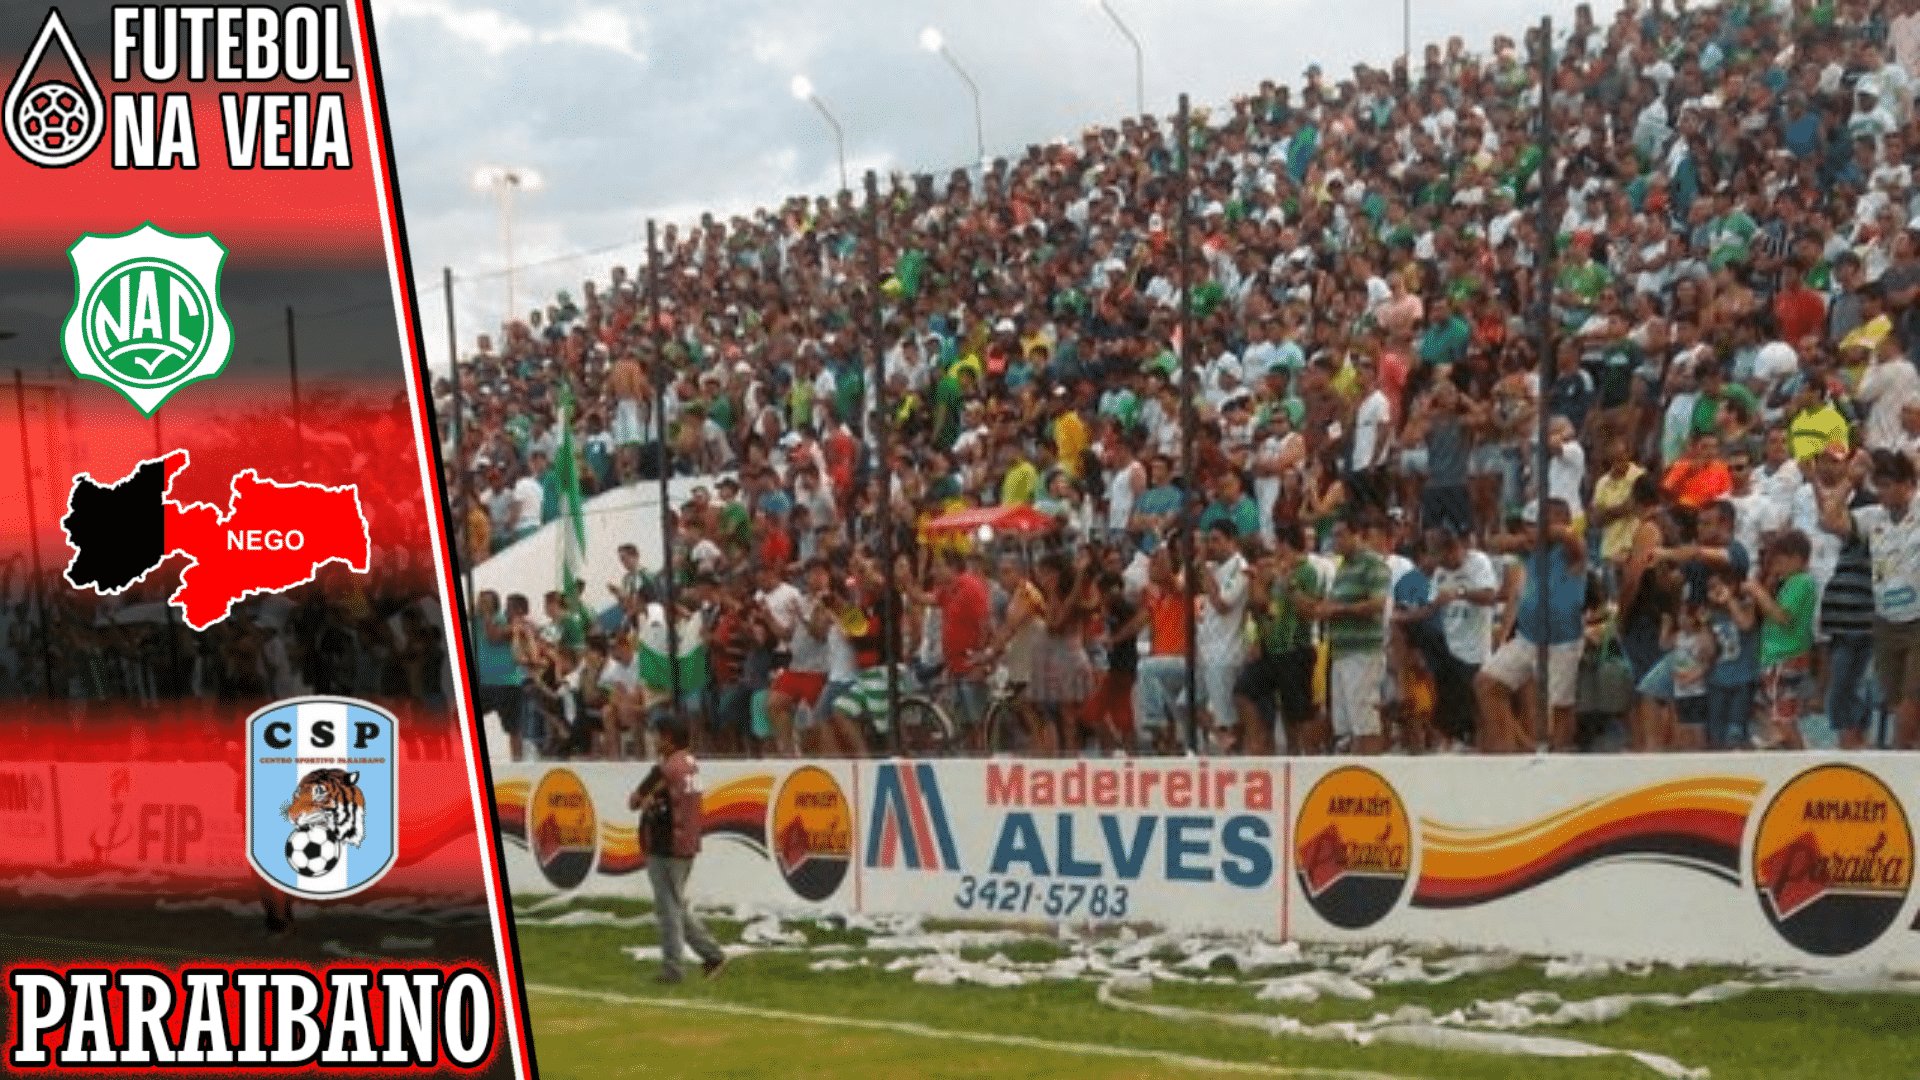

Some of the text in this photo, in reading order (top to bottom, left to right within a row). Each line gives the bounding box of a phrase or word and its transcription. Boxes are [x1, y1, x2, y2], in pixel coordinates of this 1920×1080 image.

[985, 762, 1274, 811] Madeireira
[137, 803, 204, 865] FIP
[988, 812, 1274, 890] ALVES
